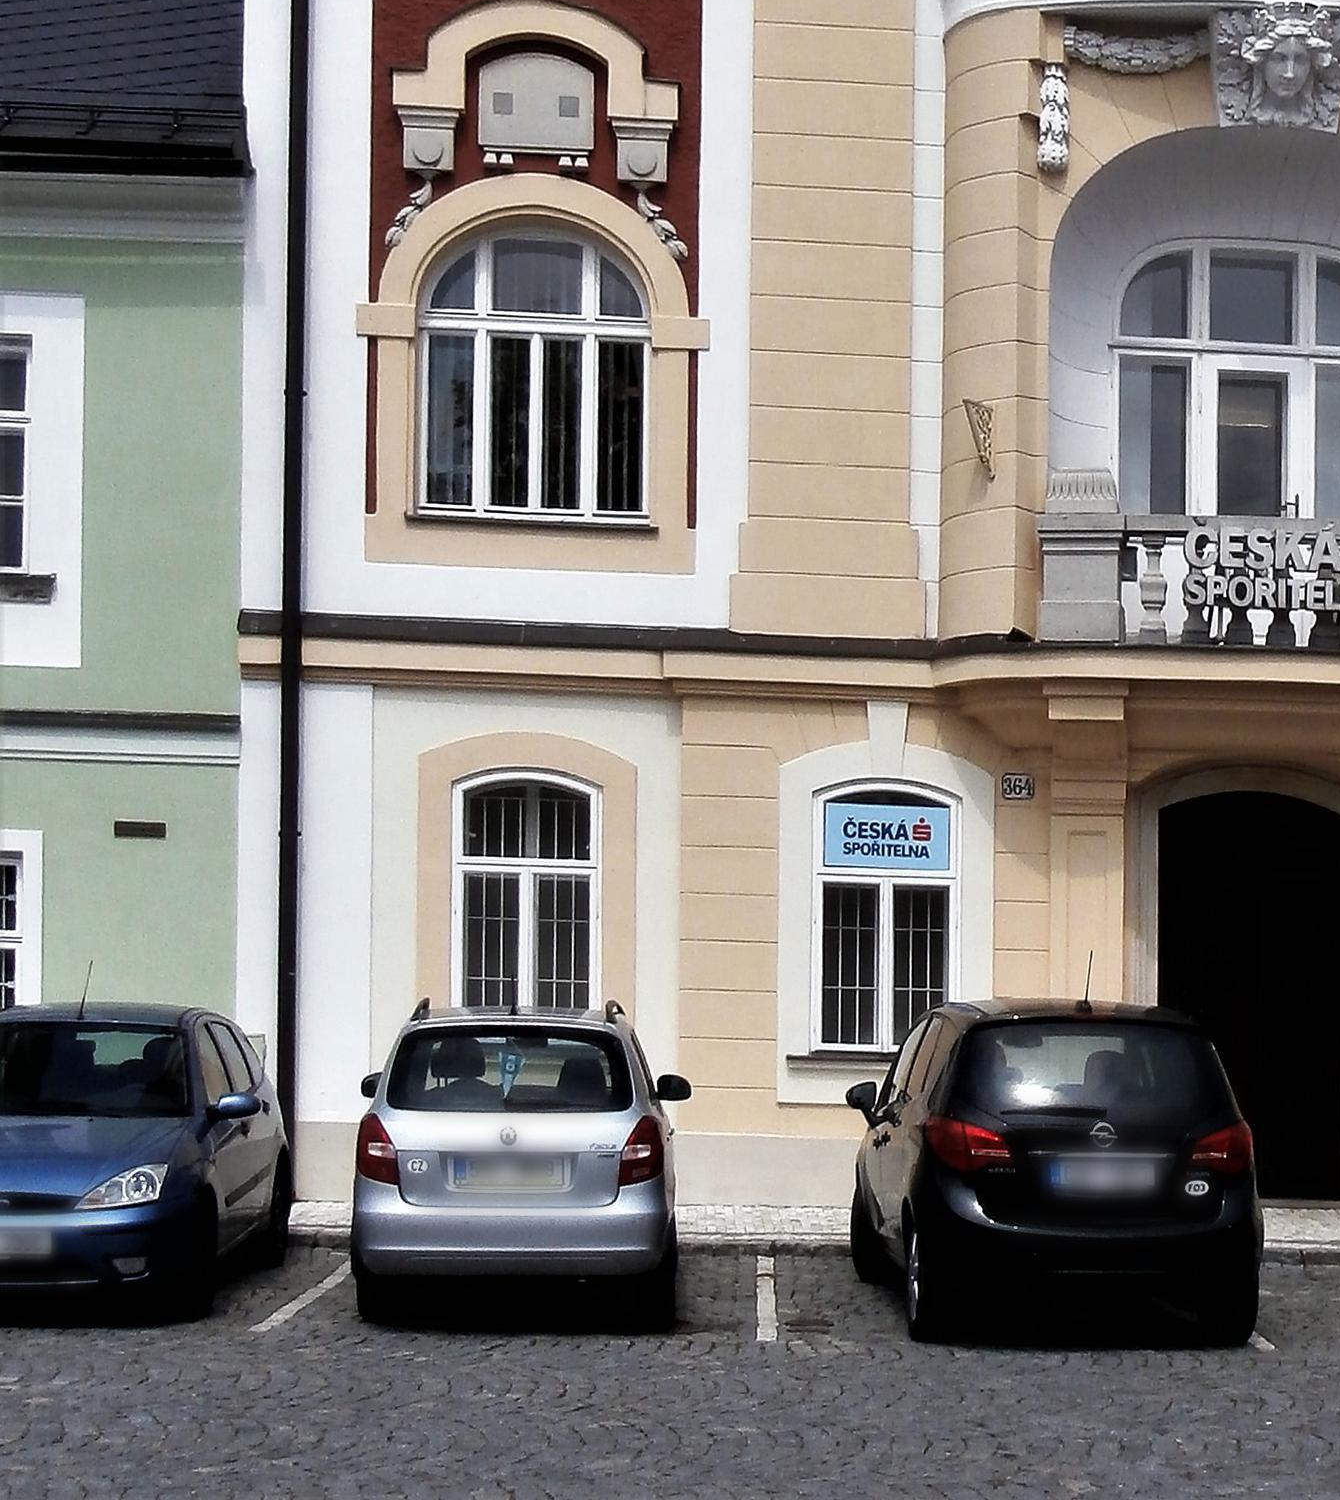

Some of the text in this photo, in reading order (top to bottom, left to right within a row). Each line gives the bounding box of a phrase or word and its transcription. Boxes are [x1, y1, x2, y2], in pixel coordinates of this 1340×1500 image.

[1003, 777, 1032, 796] 364
[842, 816, 909, 841] ČESKÁ
[842, 841, 930, 859] SPOŘITELNA
[411, 1160, 424, 1172] CZ
